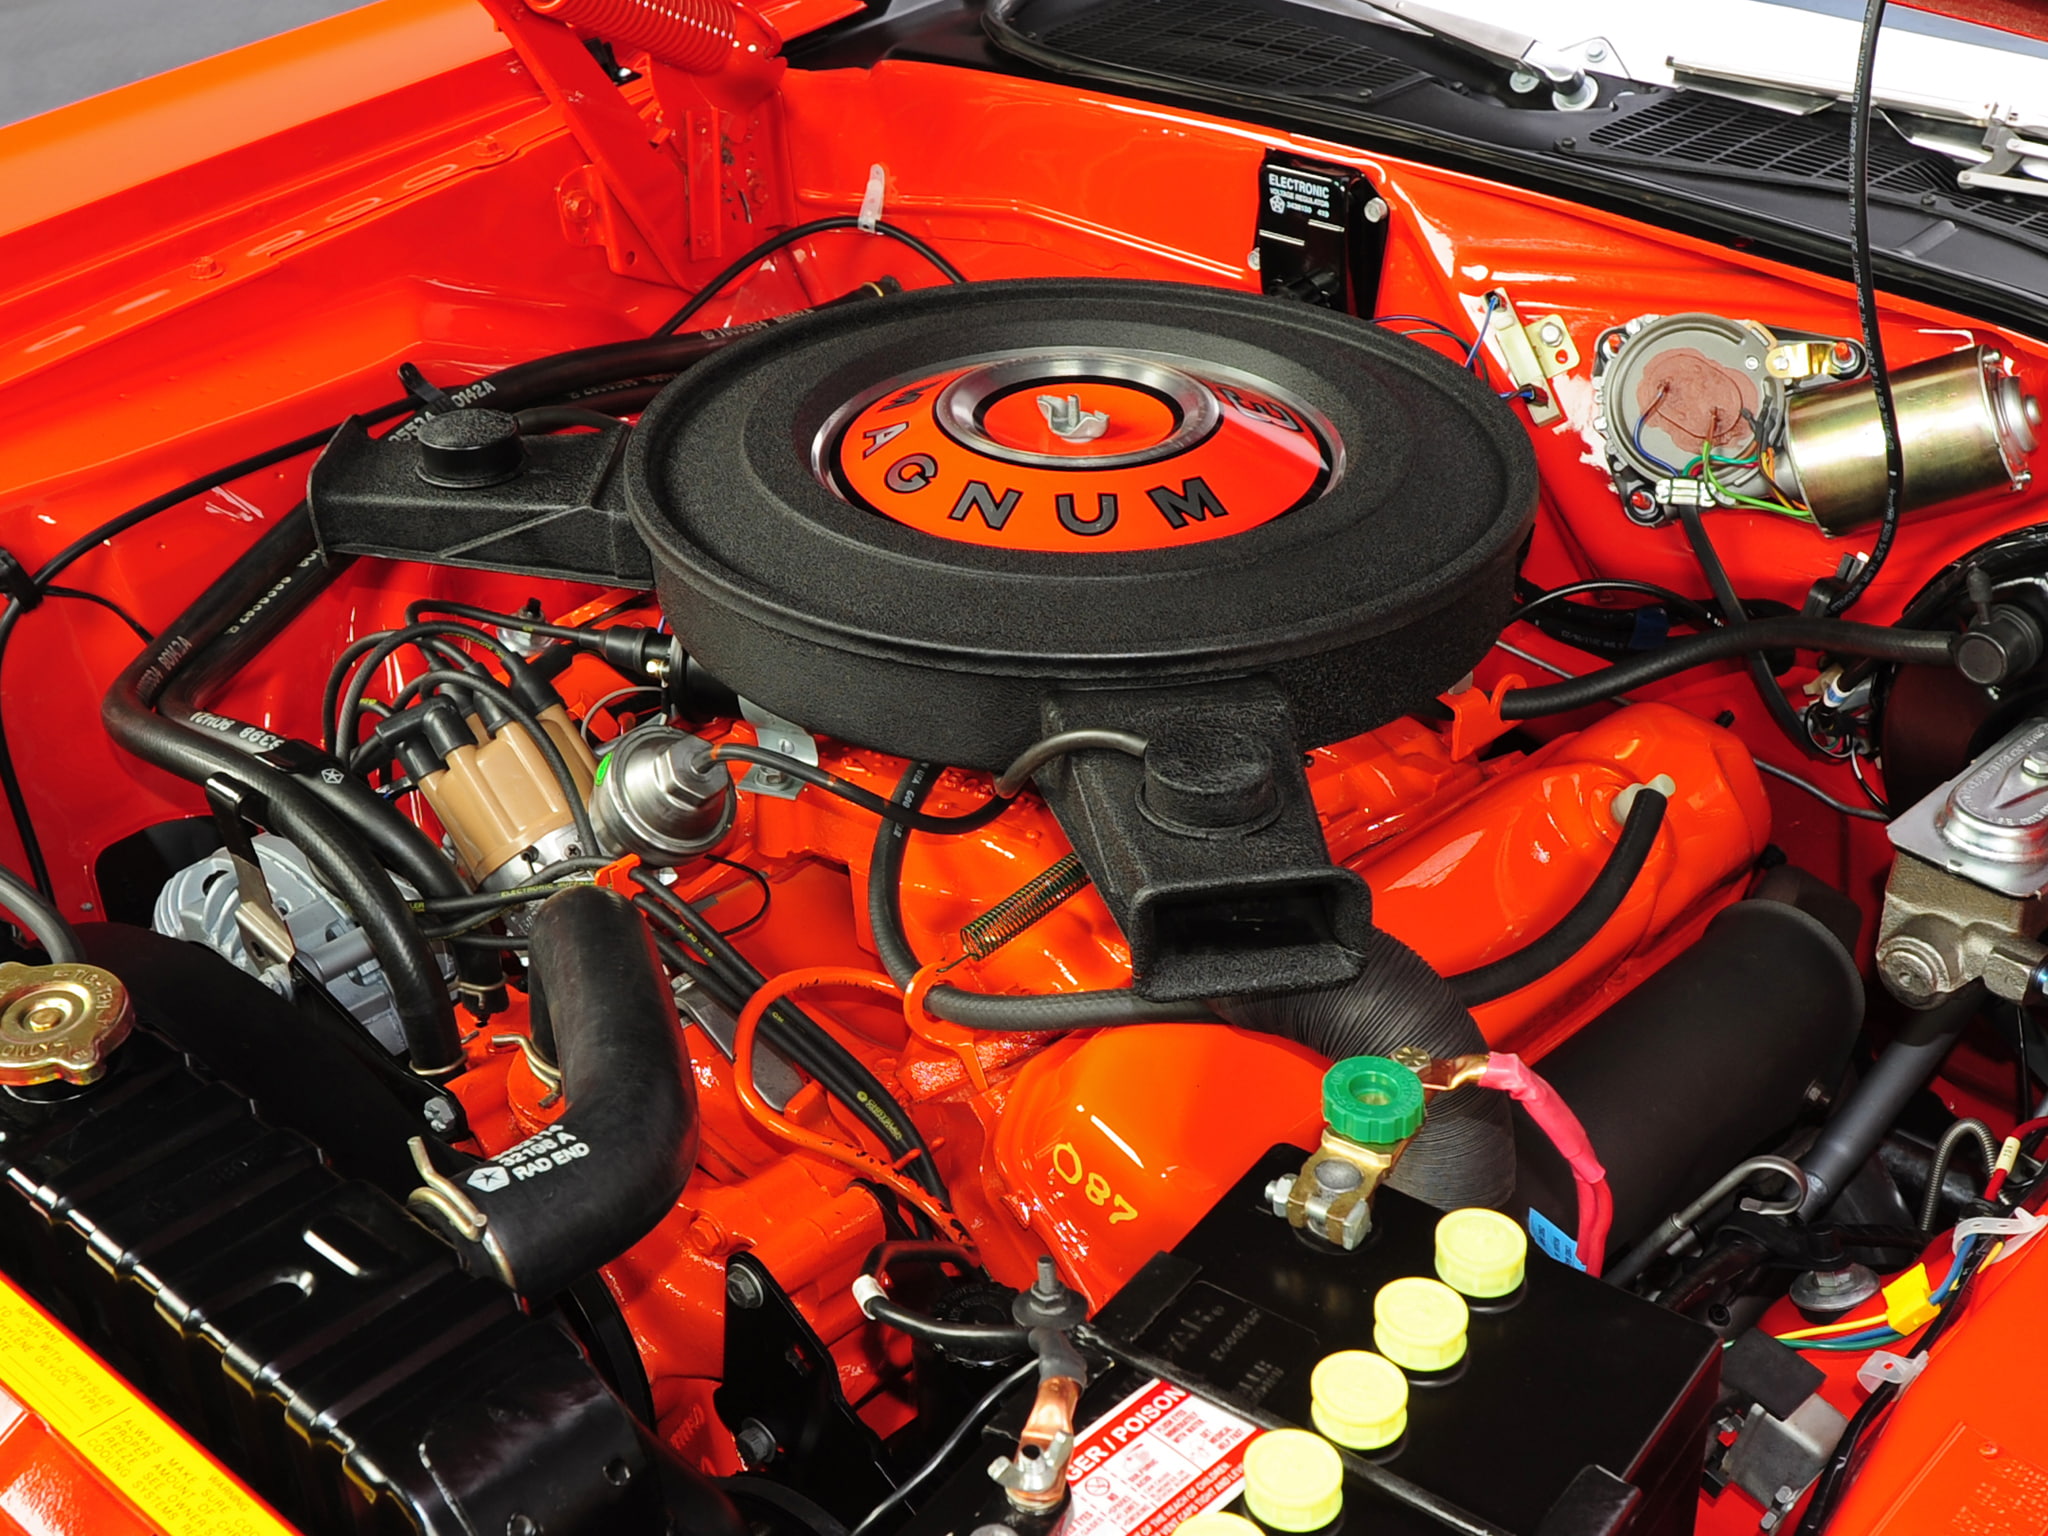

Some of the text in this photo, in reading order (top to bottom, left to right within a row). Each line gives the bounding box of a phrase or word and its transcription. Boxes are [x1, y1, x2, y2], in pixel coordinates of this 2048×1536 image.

[1268, 173, 1330, 199] ELECTRONIC
[862, 378, 1230, 533] MAGNUM
[500, 883, 554, 898] ELECTRONIC
[512, 1157, 553, 1181] RAD
[550, 1142, 590, 1166] END
[35, 1355, 70, 1388] GLYCOL
[40, 1343, 65, 1363] WITH
[66, 1366, 115, 1407] CHRYSLER
[1111, 1385, 1187, 1442] POISON
[87, 1438, 131, 1478] COOLING
[132, 1480, 179, 1520] SYSTEMS
[100, 1431, 138, 1465] FREEZE
[143, 1472, 166, 1491] SEE
[111, 1424, 151, 1459] PROPER
[153, 1463, 197, 1499] AMOUNT
[198, 1503, 215, 1516] OF
[124, 1418, 164, 1455] ALWAYS
[168, 1457, 199, 1484] MAKE
[202, 1488, 231, 1514] SURE
[208, 1474, 250, 1512] WARNING
[1162, 1495, 1188, 1517] REACH
[1185, 1486, 1197, 1499] OF
[1177, 1503, 1199, 1523] CAPS
[1194, 1487, 1217, 1507] TIGHT
[1213, 1476, 1232, 1491] AND
